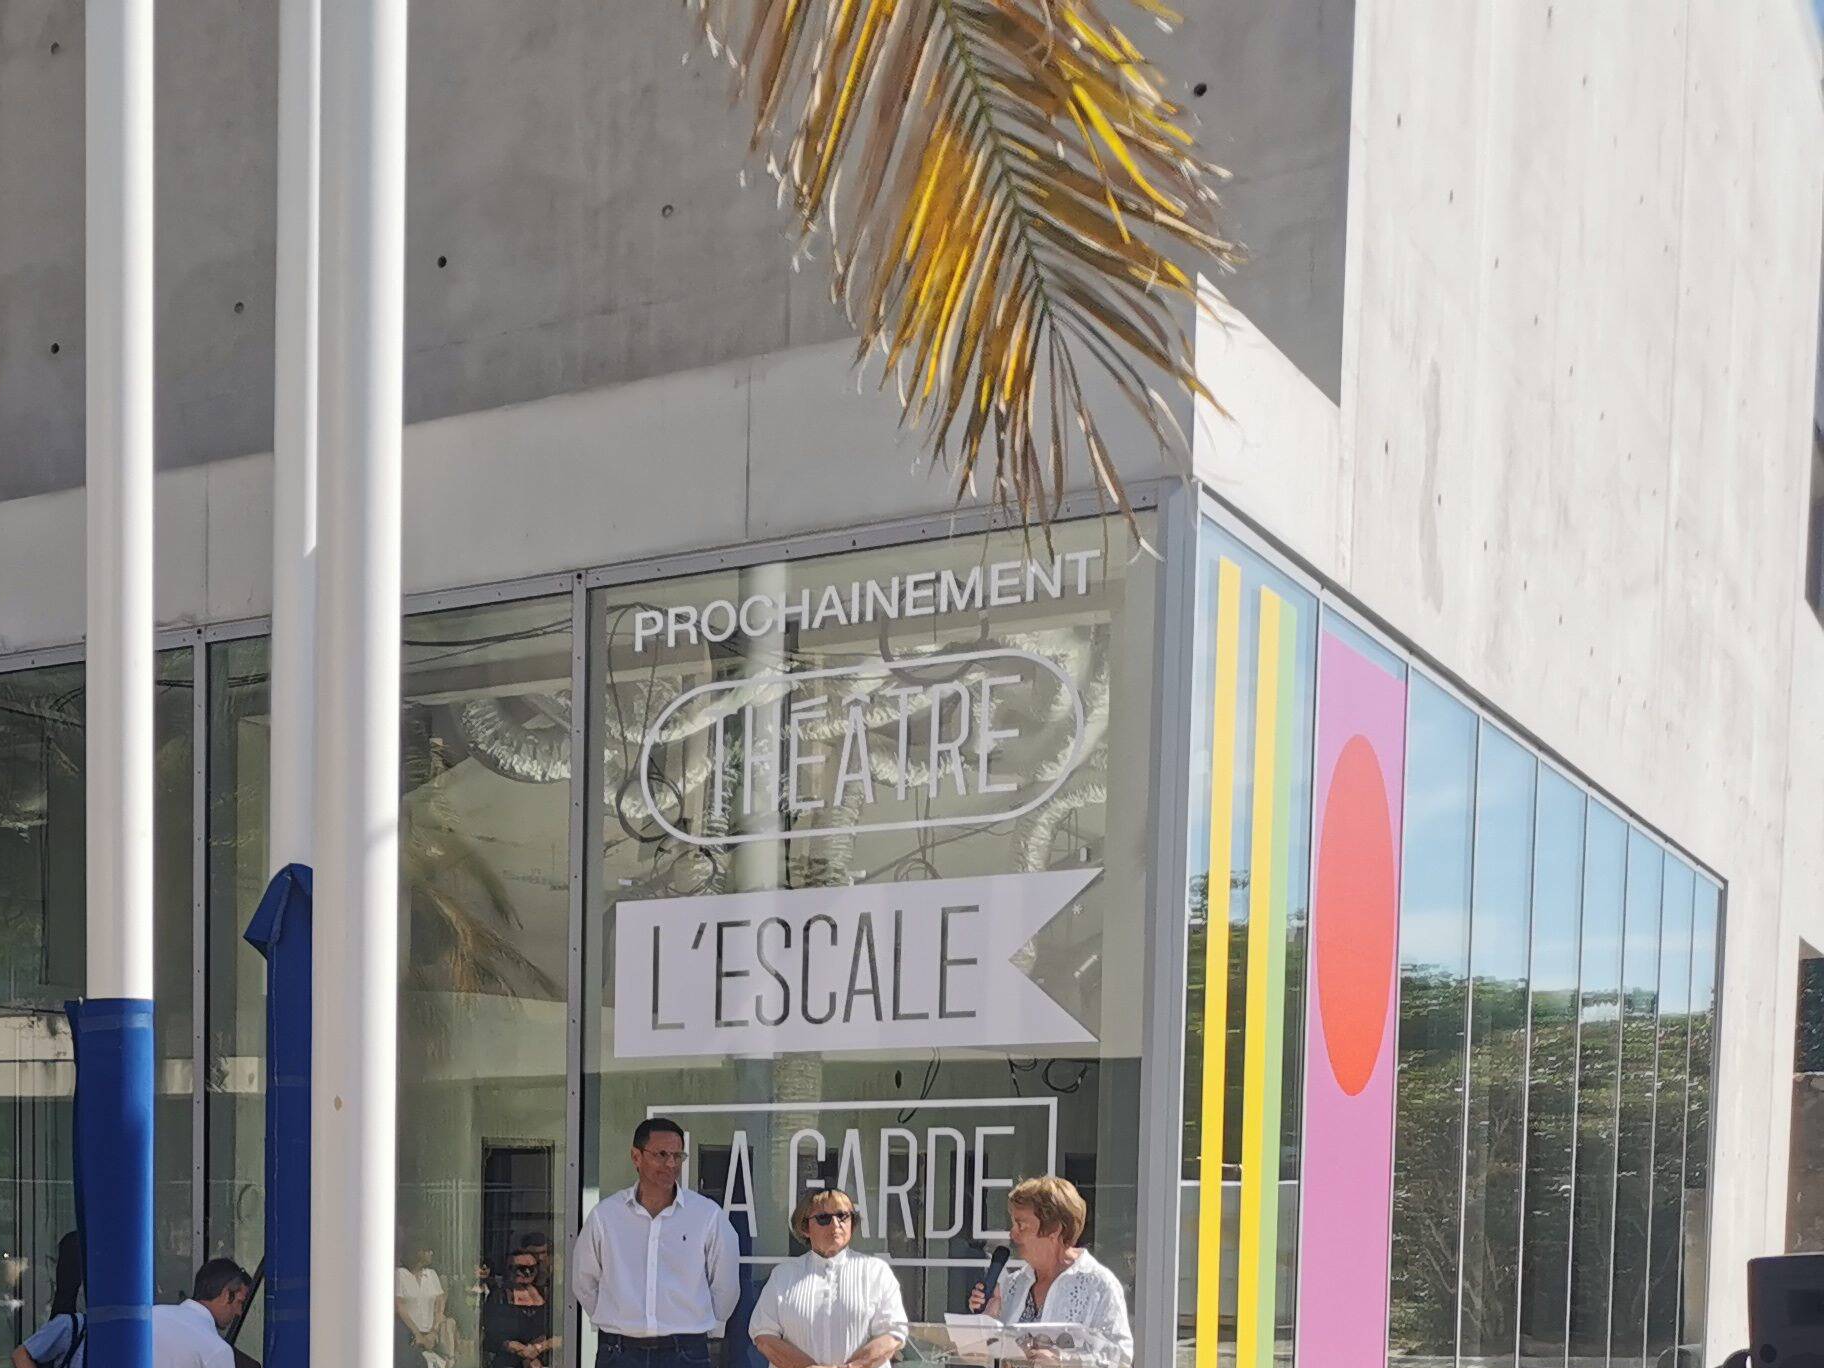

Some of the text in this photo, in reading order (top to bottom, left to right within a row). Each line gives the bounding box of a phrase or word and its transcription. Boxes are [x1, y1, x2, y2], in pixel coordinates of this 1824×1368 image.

[634, 548, 1102, 653] PROCHAINEMENT
[700, 672, 1024, 819] THÉÂTRE
[650, 904, 980, 1031] L'ESCALE
[788, 1125, 1016, 1240] GARDE
